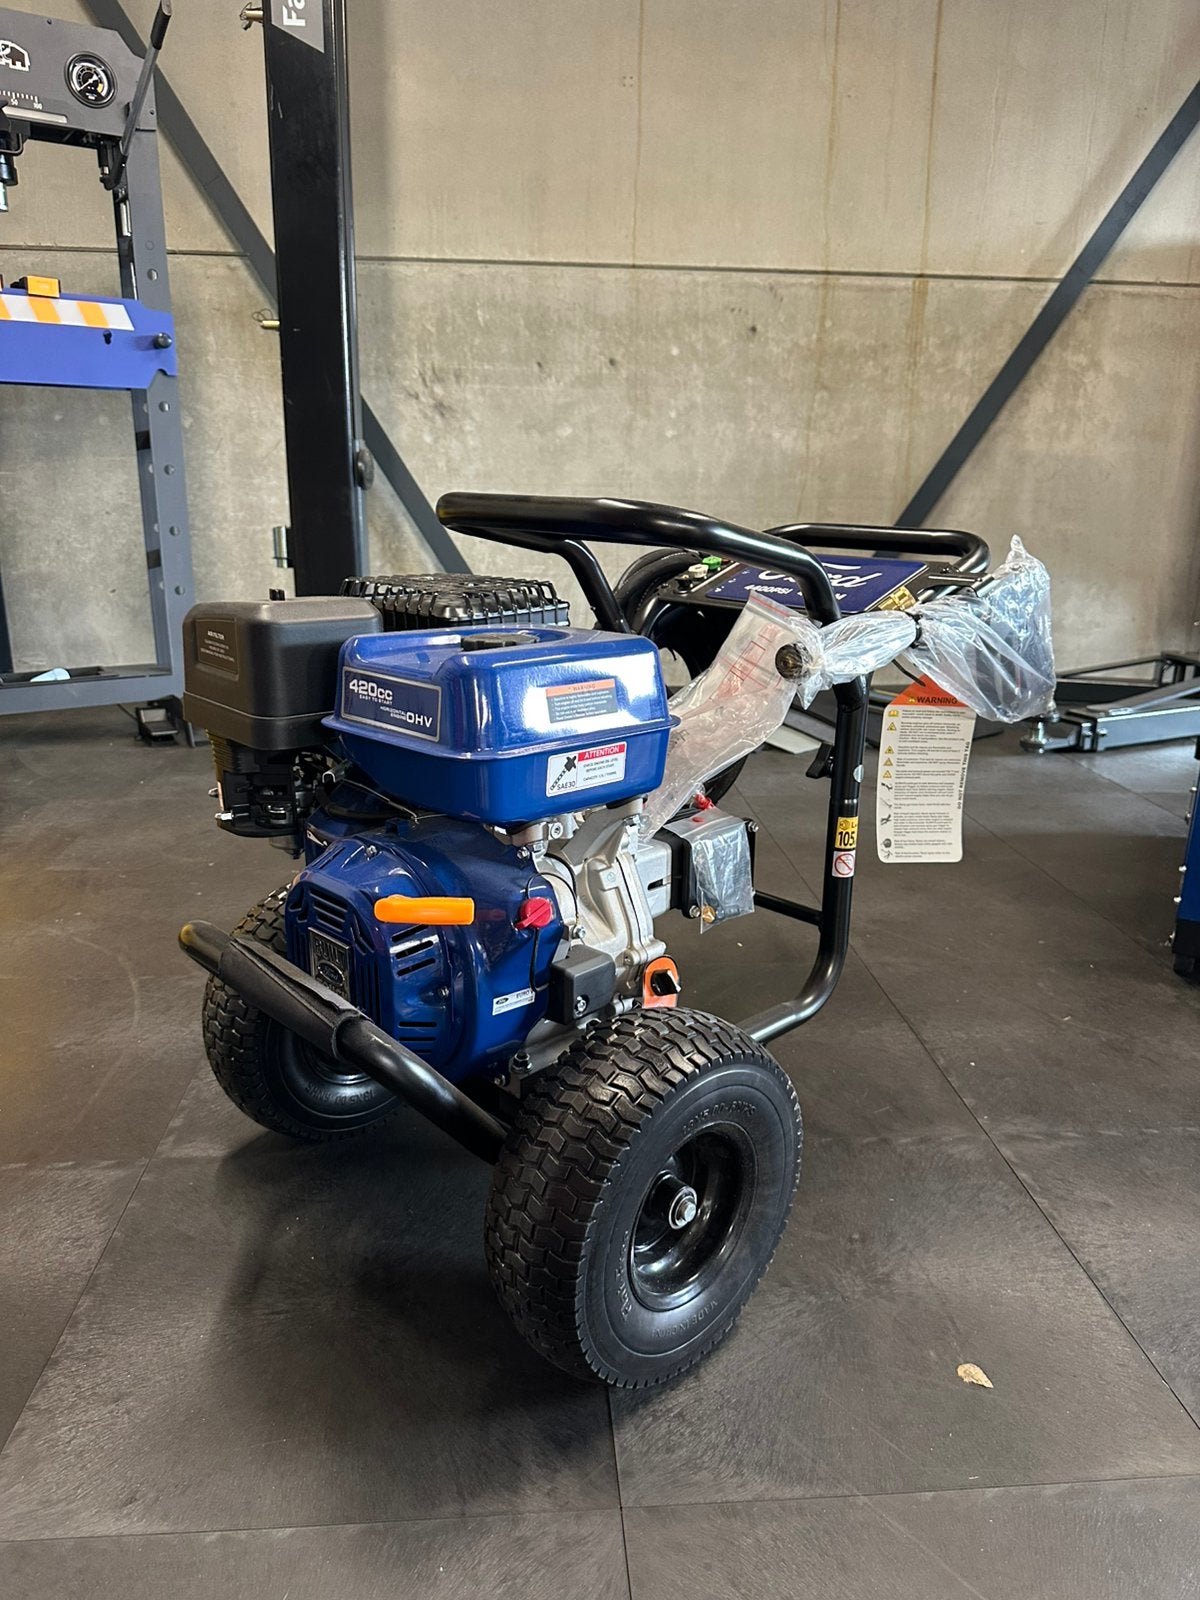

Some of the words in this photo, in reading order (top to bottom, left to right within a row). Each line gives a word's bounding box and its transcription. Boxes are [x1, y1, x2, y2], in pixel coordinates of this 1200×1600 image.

[573, 683, 596, 692] WARNING
[378, 698, 393, 706] START
[917, 696, 958, 705] WARNING
[406, 711, 433, 728] OHV
[584, 746, 620, 759] ATTENTION
[556, 781, 576, 791] SAE30
[838, 831, 856, 847] 105
